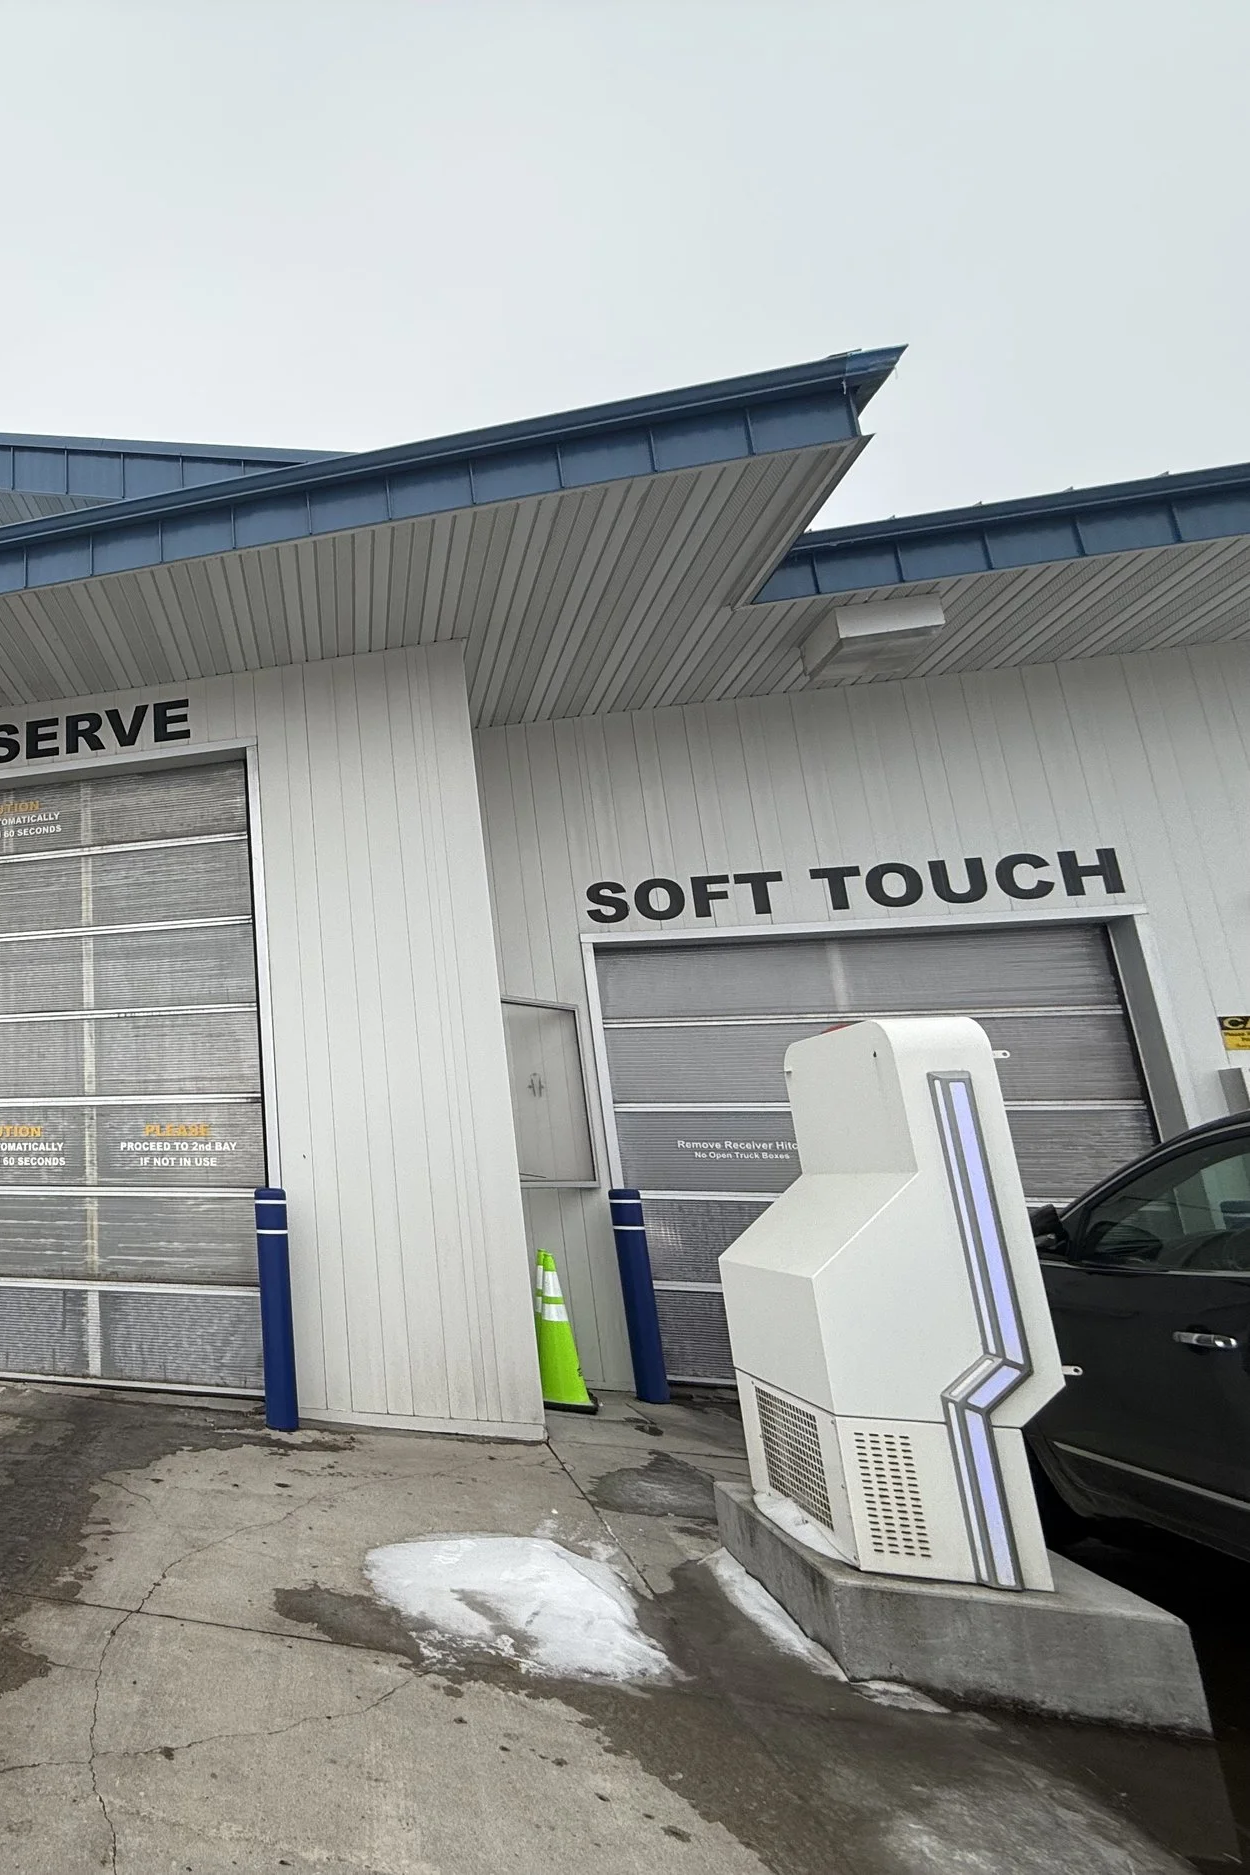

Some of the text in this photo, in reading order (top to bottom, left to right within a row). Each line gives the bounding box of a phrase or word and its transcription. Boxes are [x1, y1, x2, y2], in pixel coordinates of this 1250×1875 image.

[4, 830, 15, 838] 60
[17, 824, 62, 837] SECONDS
[586, 847, 1126, 924] SOFT TOUCH
[1223, 1017, 1250, 1029] C
[144, 1124, 210, 1137] PLEASE
[120, 1142, 237, 1151] PROCEED TO 2nd BAY
[677, 1140, 721, 1149] Remove
[724, 1140, 773, 1149] Receiver
[694, 1151, 790, 1160] No Open Truck Boxes
[3, 1157, 15, 1166] 60
[17, 1157, 66, 1166] SECONDS
[140, 1157, 217, 1167] IF NOT IN USE
